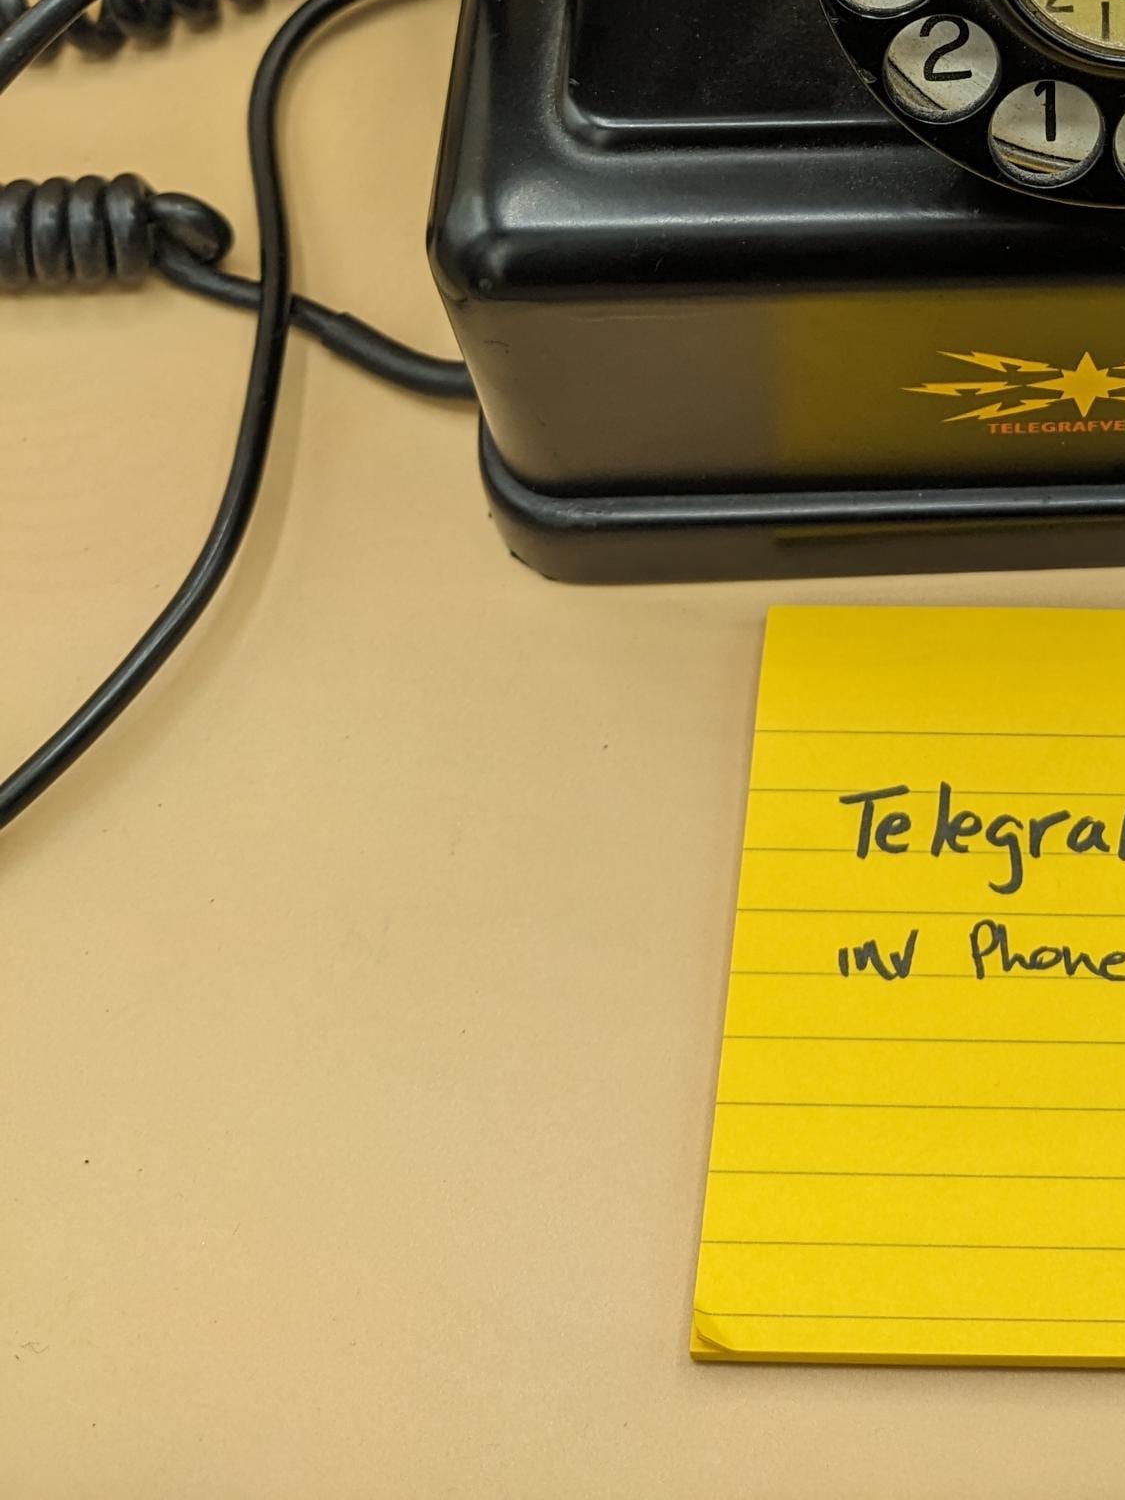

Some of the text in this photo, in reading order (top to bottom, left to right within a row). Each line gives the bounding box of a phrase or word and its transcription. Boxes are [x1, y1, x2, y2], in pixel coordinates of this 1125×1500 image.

[920, 18, 972, 81] 2
[1101, 2, 1110, 41] 1
[1035, 81, 1057, 141] 1
